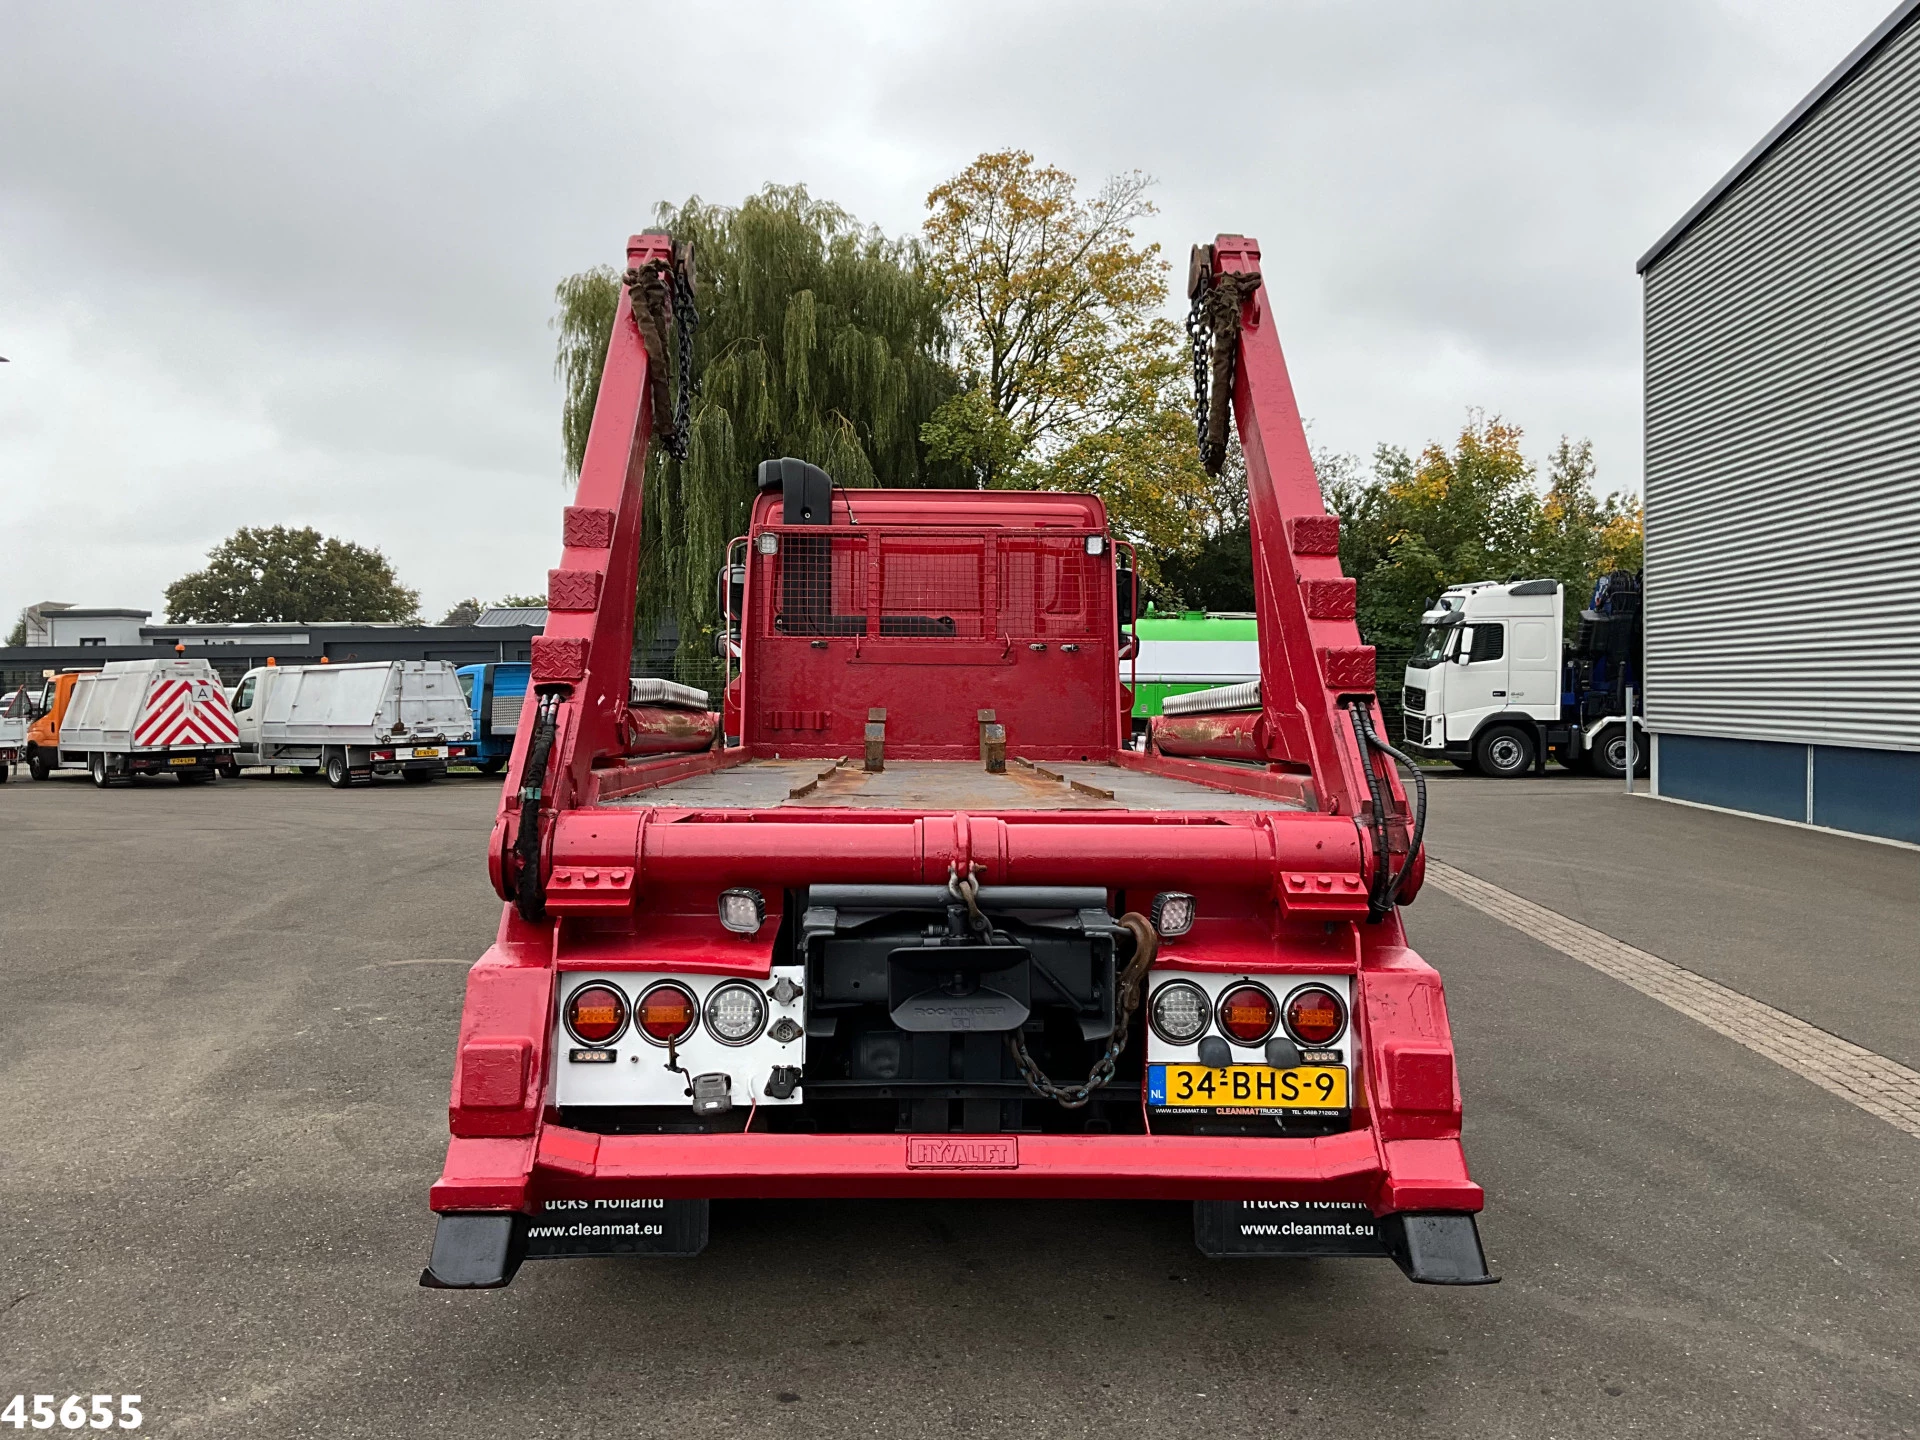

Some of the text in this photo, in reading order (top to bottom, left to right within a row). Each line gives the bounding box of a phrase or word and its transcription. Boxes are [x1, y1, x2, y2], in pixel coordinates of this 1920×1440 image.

[198, 688, 208, 699] A
[914, 1007, 1005, 1016] ROCKINGER
[1150, 1090, 1164, 1099] NL
[917, 1139, 1008, 1163] HYVALIFT
[594, 1198, 664, 1209] Holland
[528, 1222, 663, 1238] www.cleanmat.eu
[1240, 1221, 1374, 1236] www.cleanmat.eu
